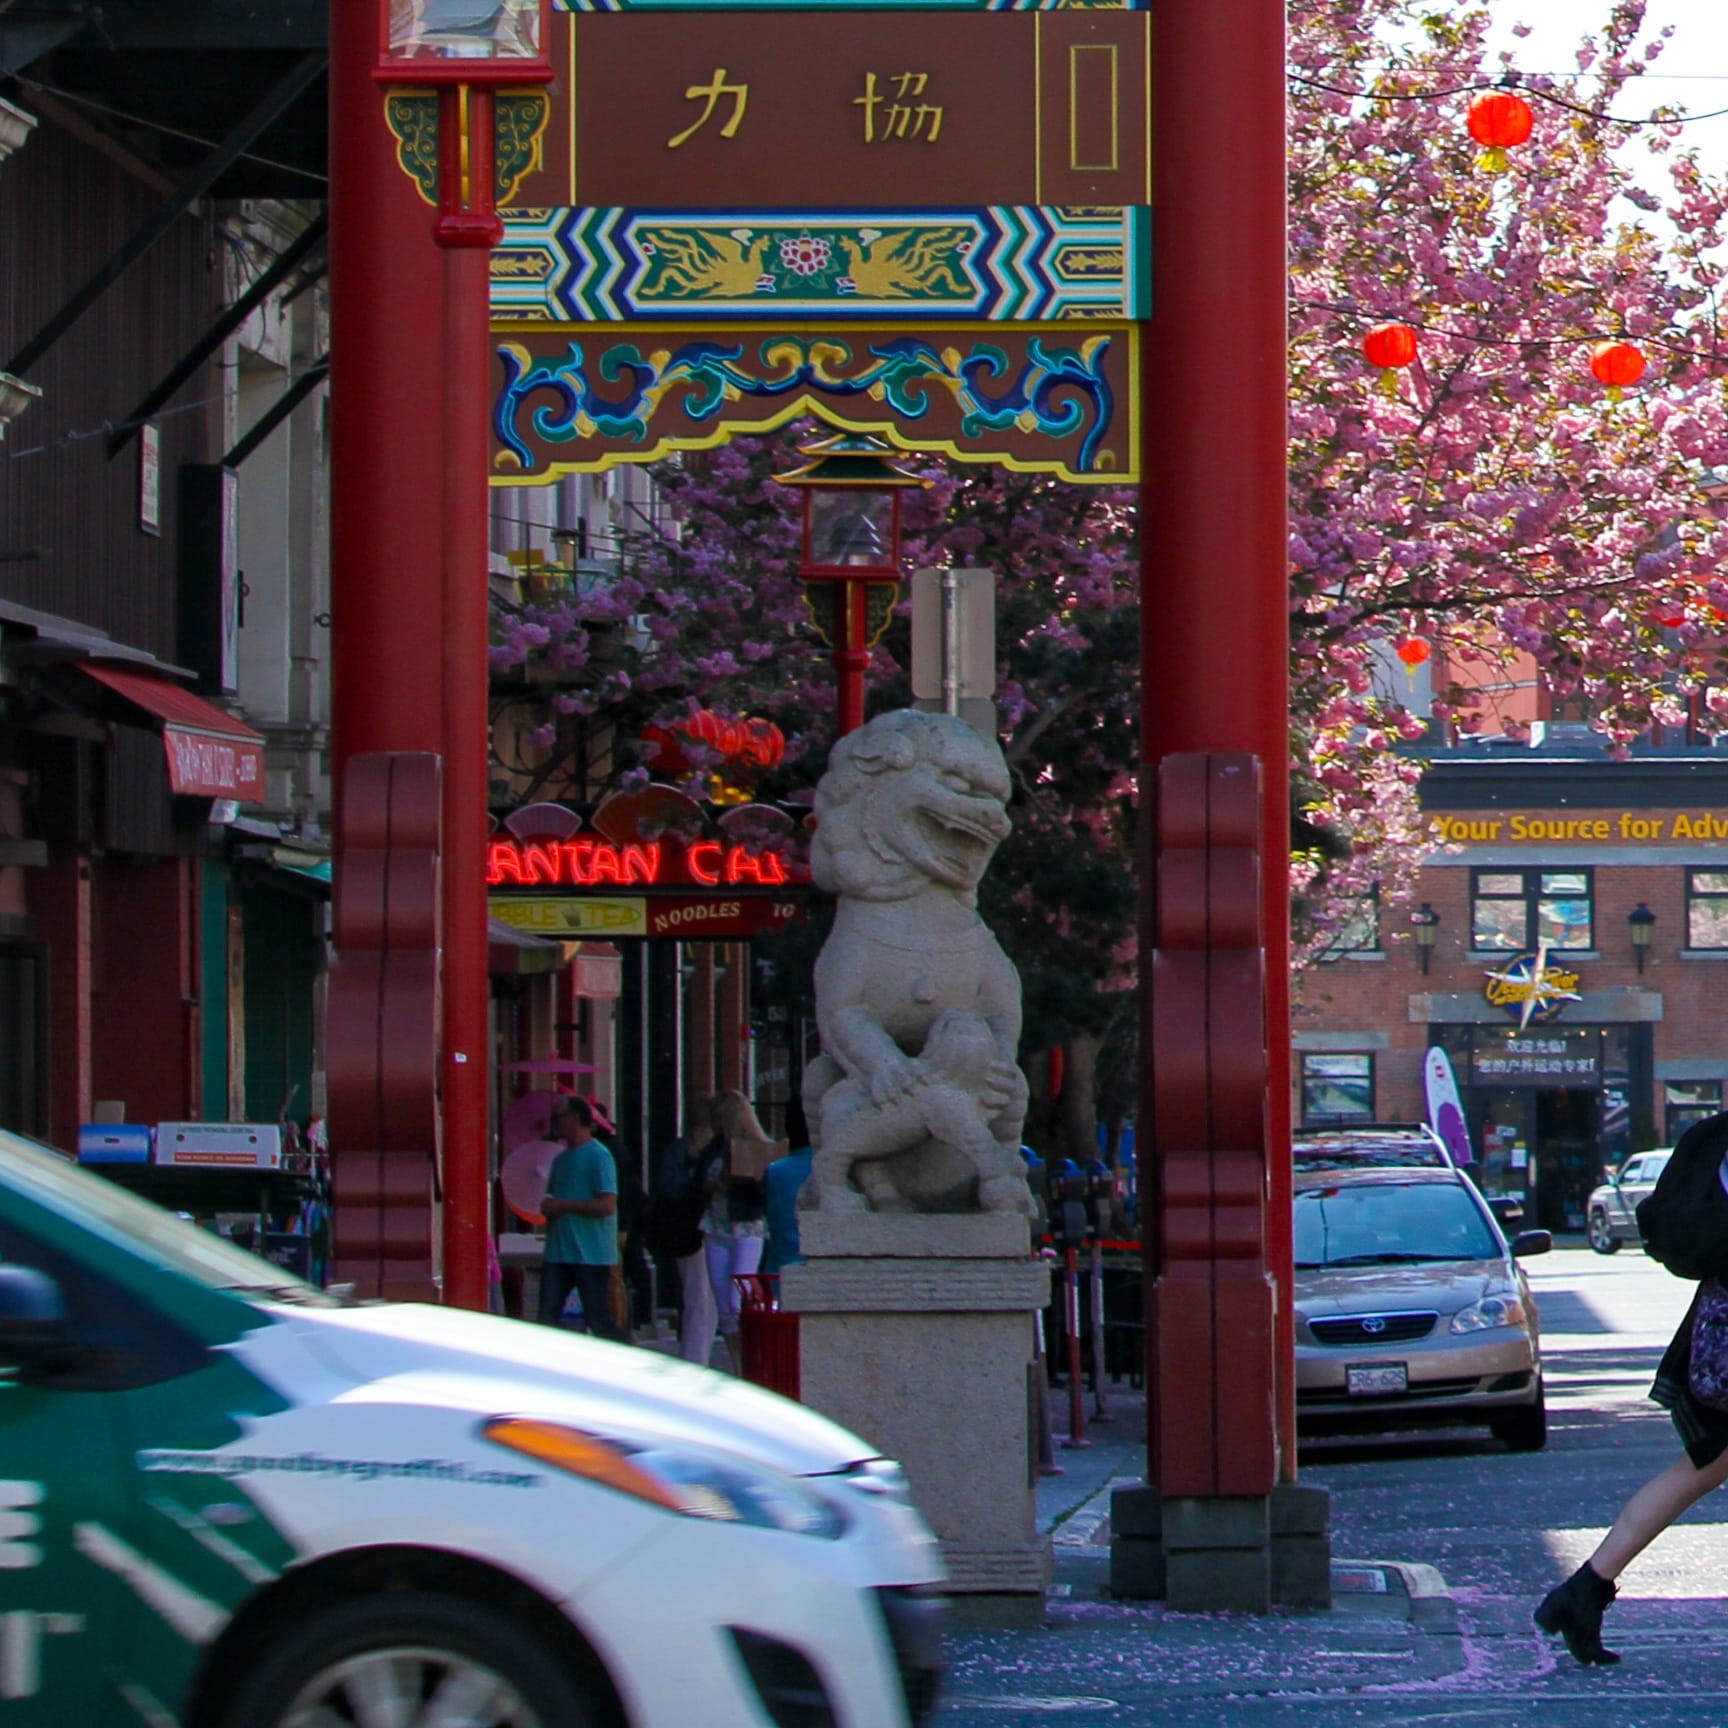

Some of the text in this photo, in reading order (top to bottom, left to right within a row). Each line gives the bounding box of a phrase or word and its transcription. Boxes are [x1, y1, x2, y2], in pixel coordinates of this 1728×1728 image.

[1435, 815, 1502, 841] Your
[1509, 814, 1611, 841] Source
[1618, 812, 1663, 839] for
[485, 841, 660, 884] ANTAN
[653, 902, 742, 933] NOODLES
